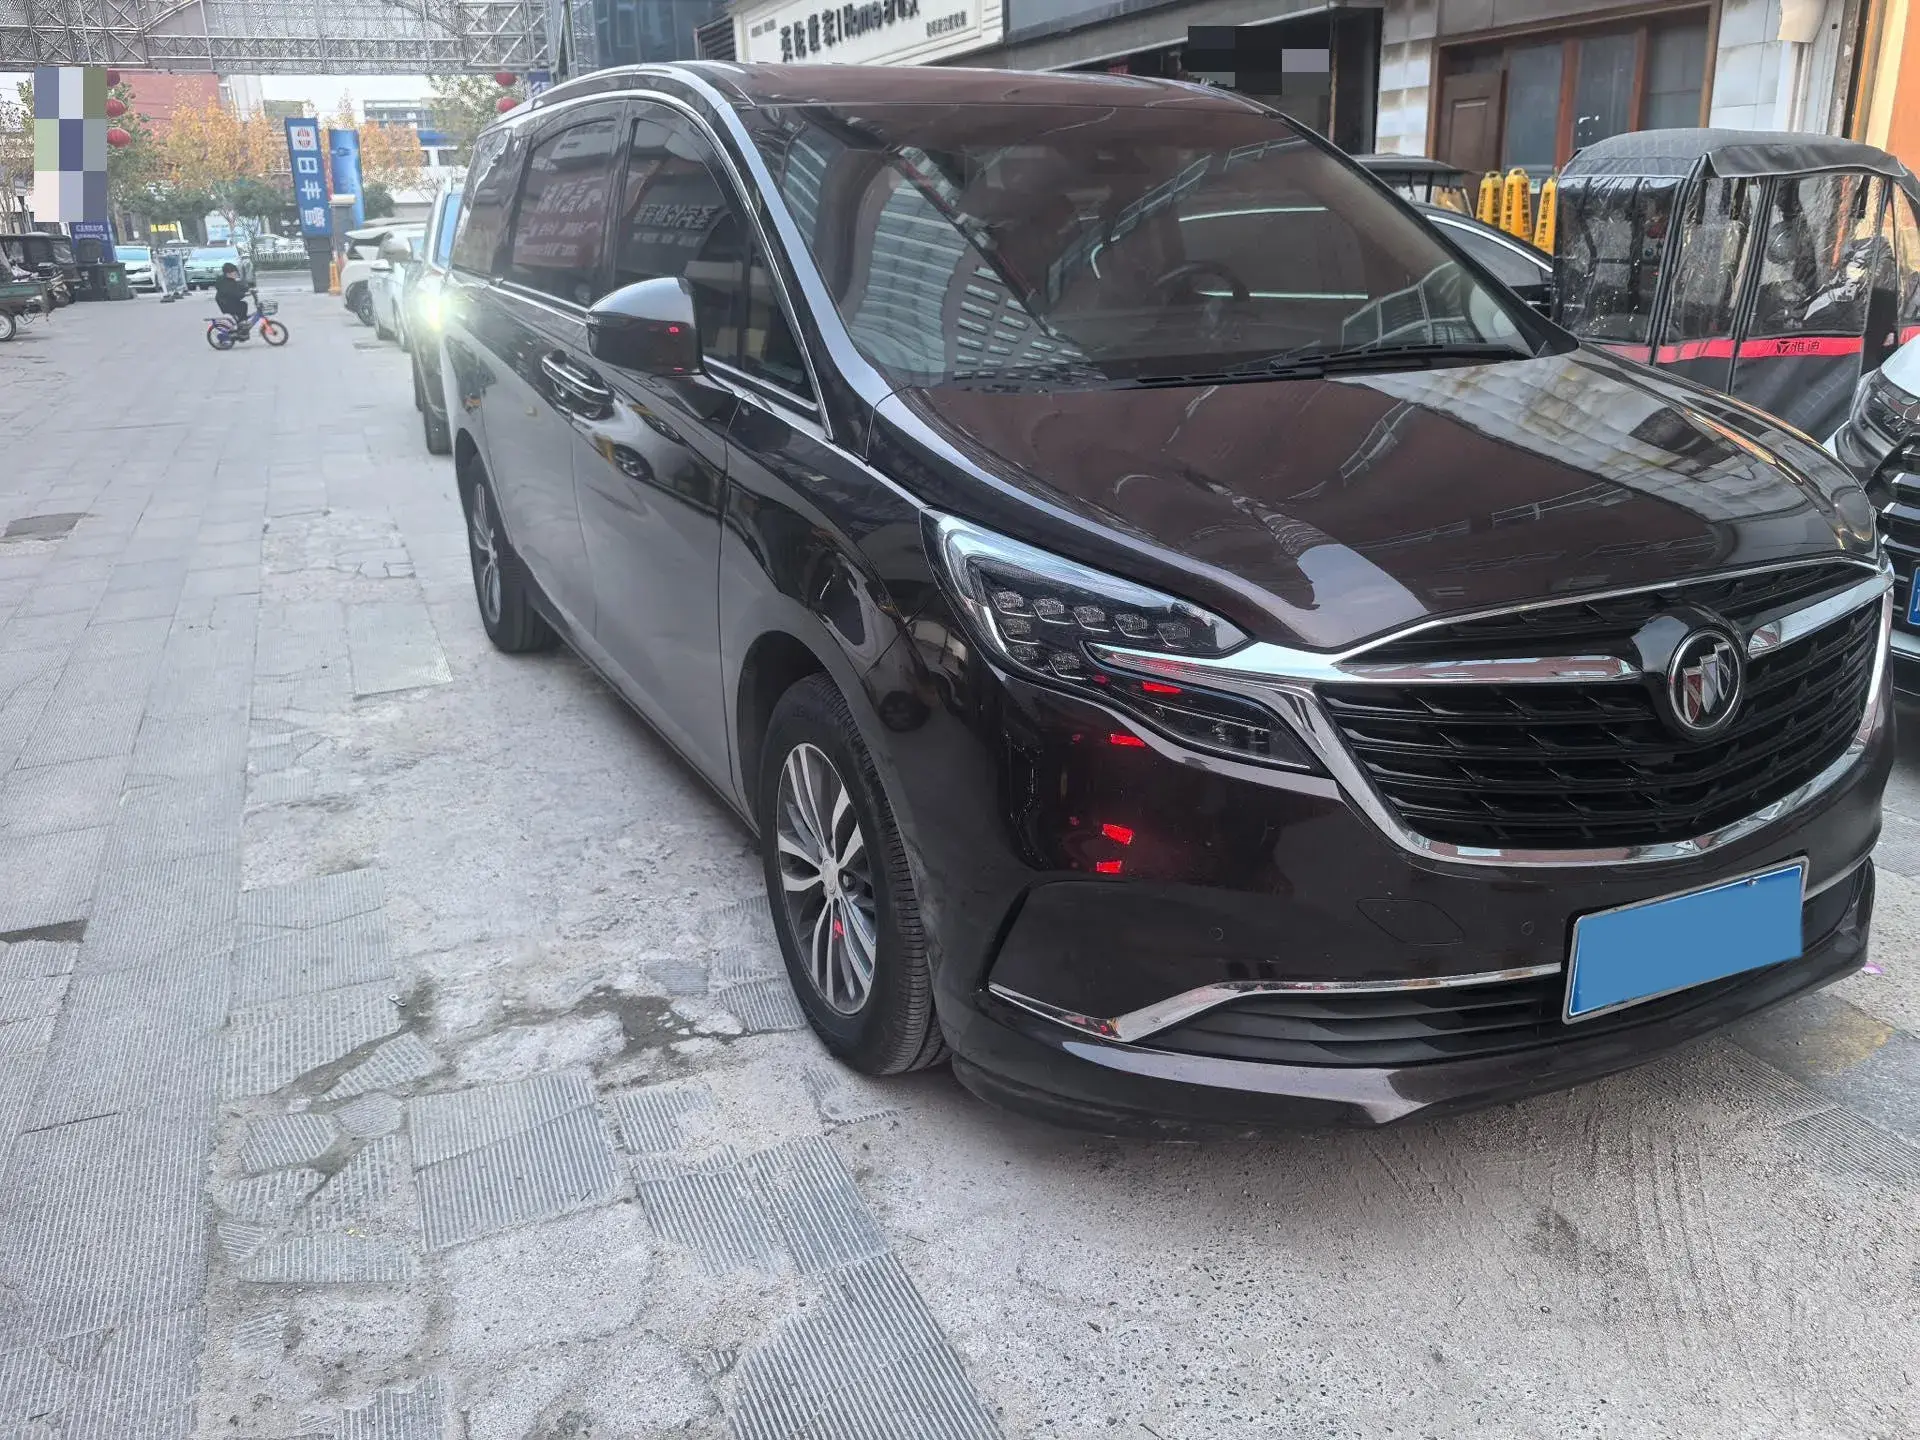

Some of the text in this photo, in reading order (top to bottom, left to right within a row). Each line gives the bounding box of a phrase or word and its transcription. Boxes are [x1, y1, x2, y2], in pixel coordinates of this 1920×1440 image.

[298, 157, 325, 227] 日丰管
[1791, 341, 1820, 352] 雅迪
